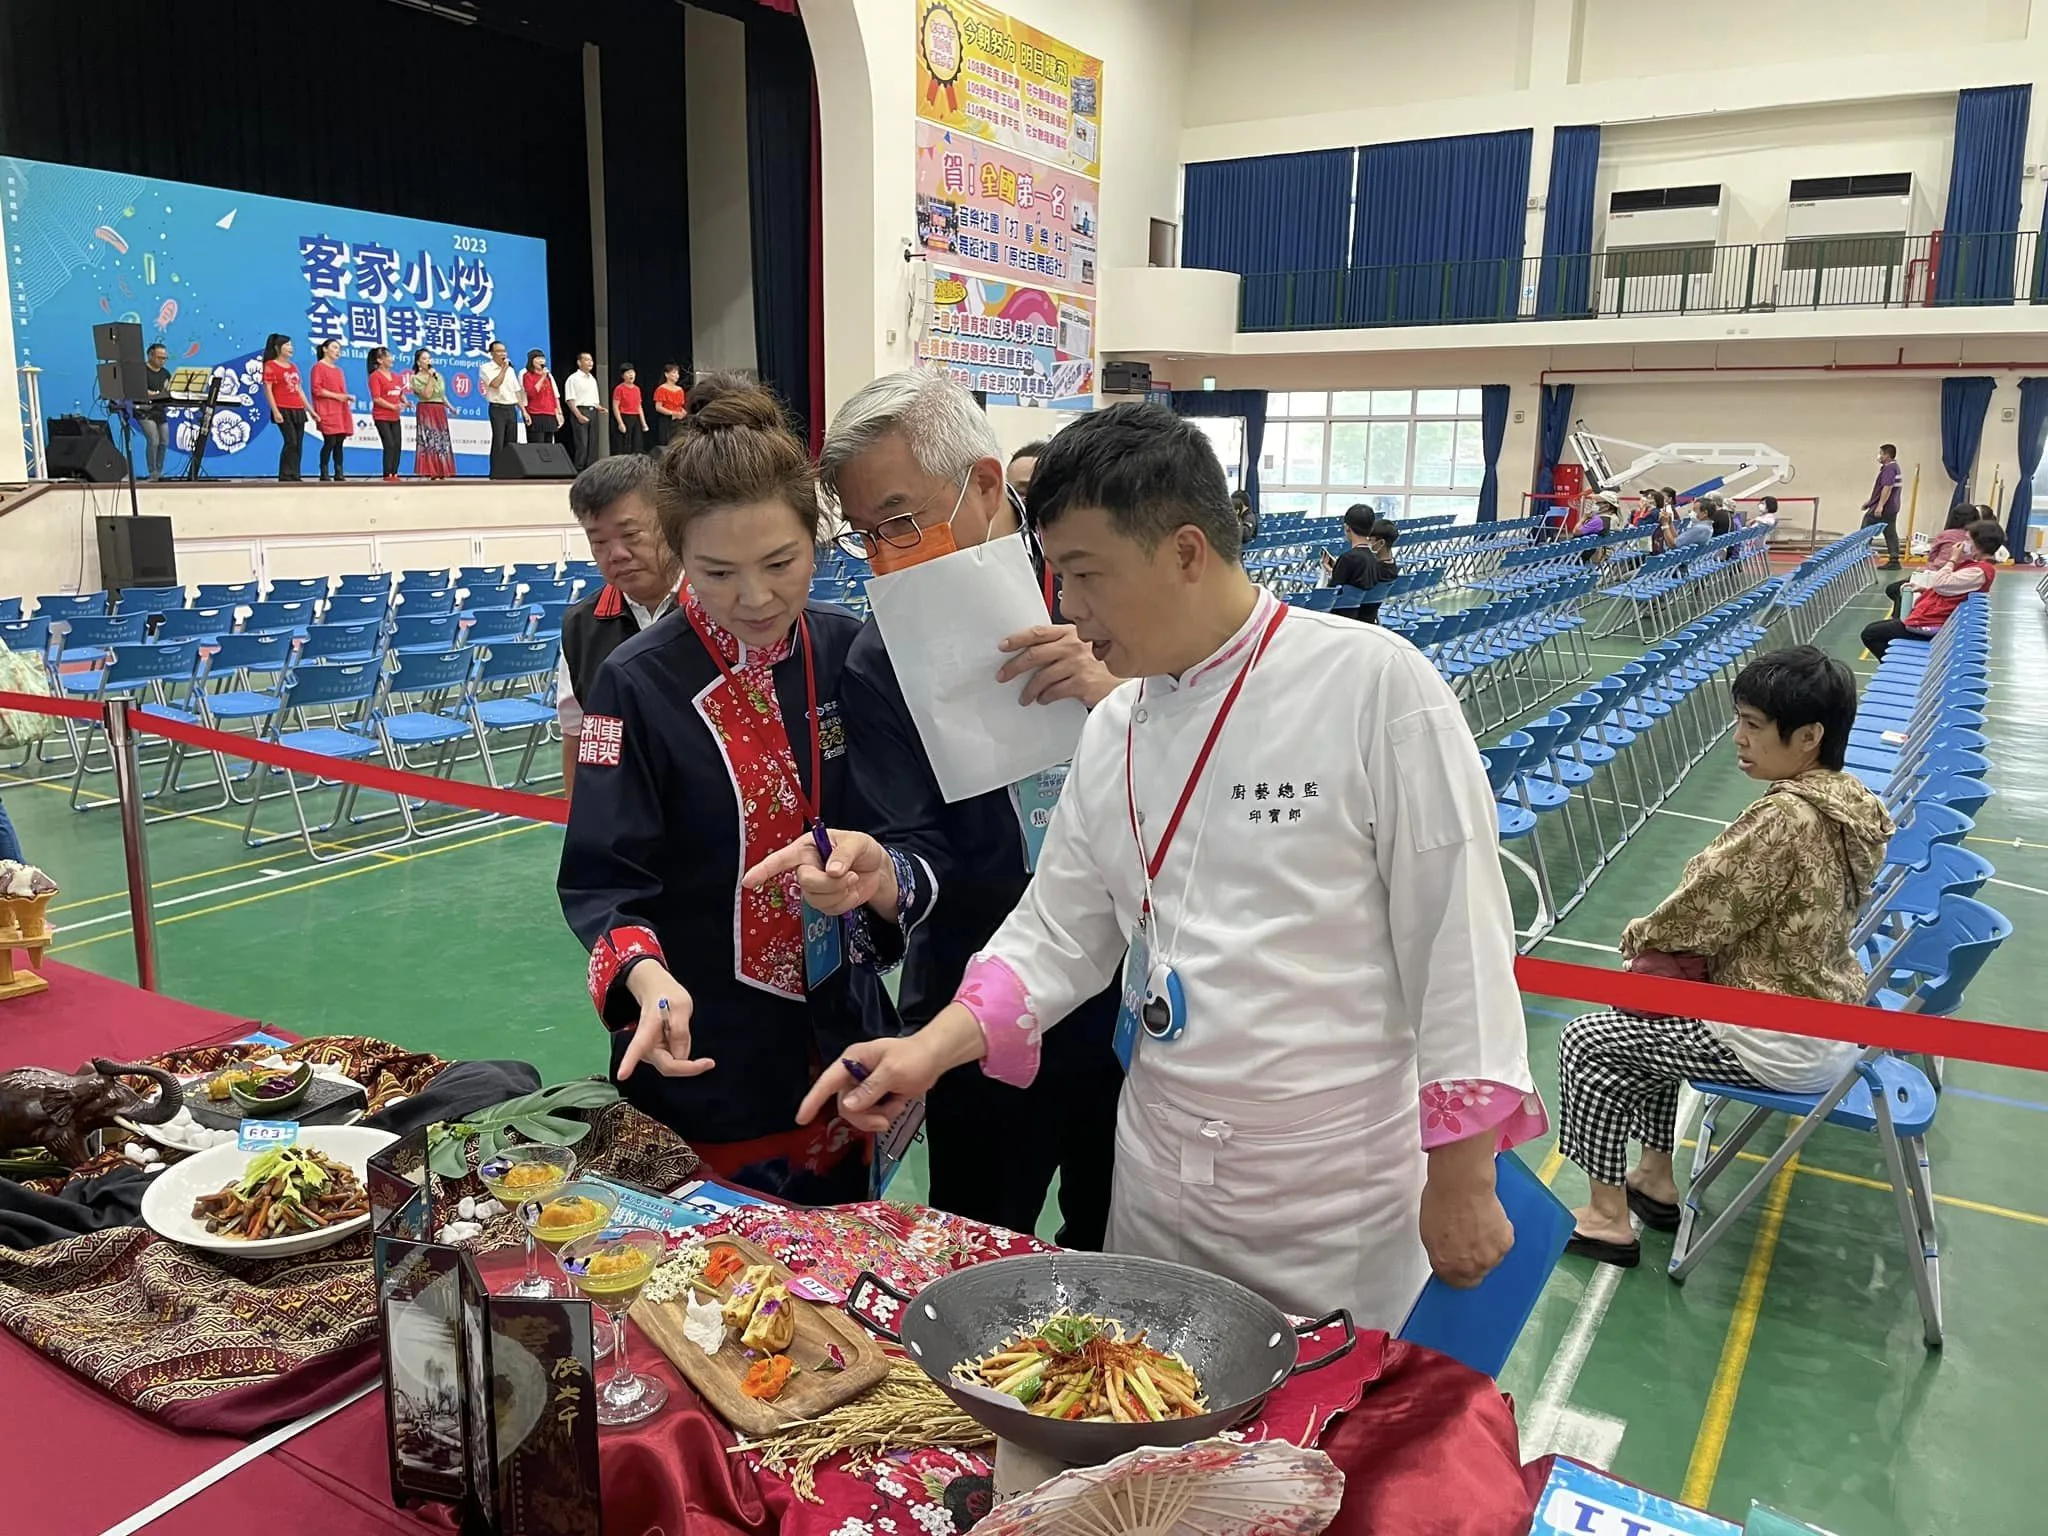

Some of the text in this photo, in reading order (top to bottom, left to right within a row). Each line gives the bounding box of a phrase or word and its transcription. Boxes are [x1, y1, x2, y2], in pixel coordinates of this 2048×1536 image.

[959, 206, 1000, 234] 音樂社團
[452, 235, 488, 254] 2023
[958, 235, 999, 263] 舞蹈社團
[299, 233, 494, 314] 客家小炒
[306, 297, 498, 358] 全國爭霸賽
[1574, 1500, 1674, 1536] 11
